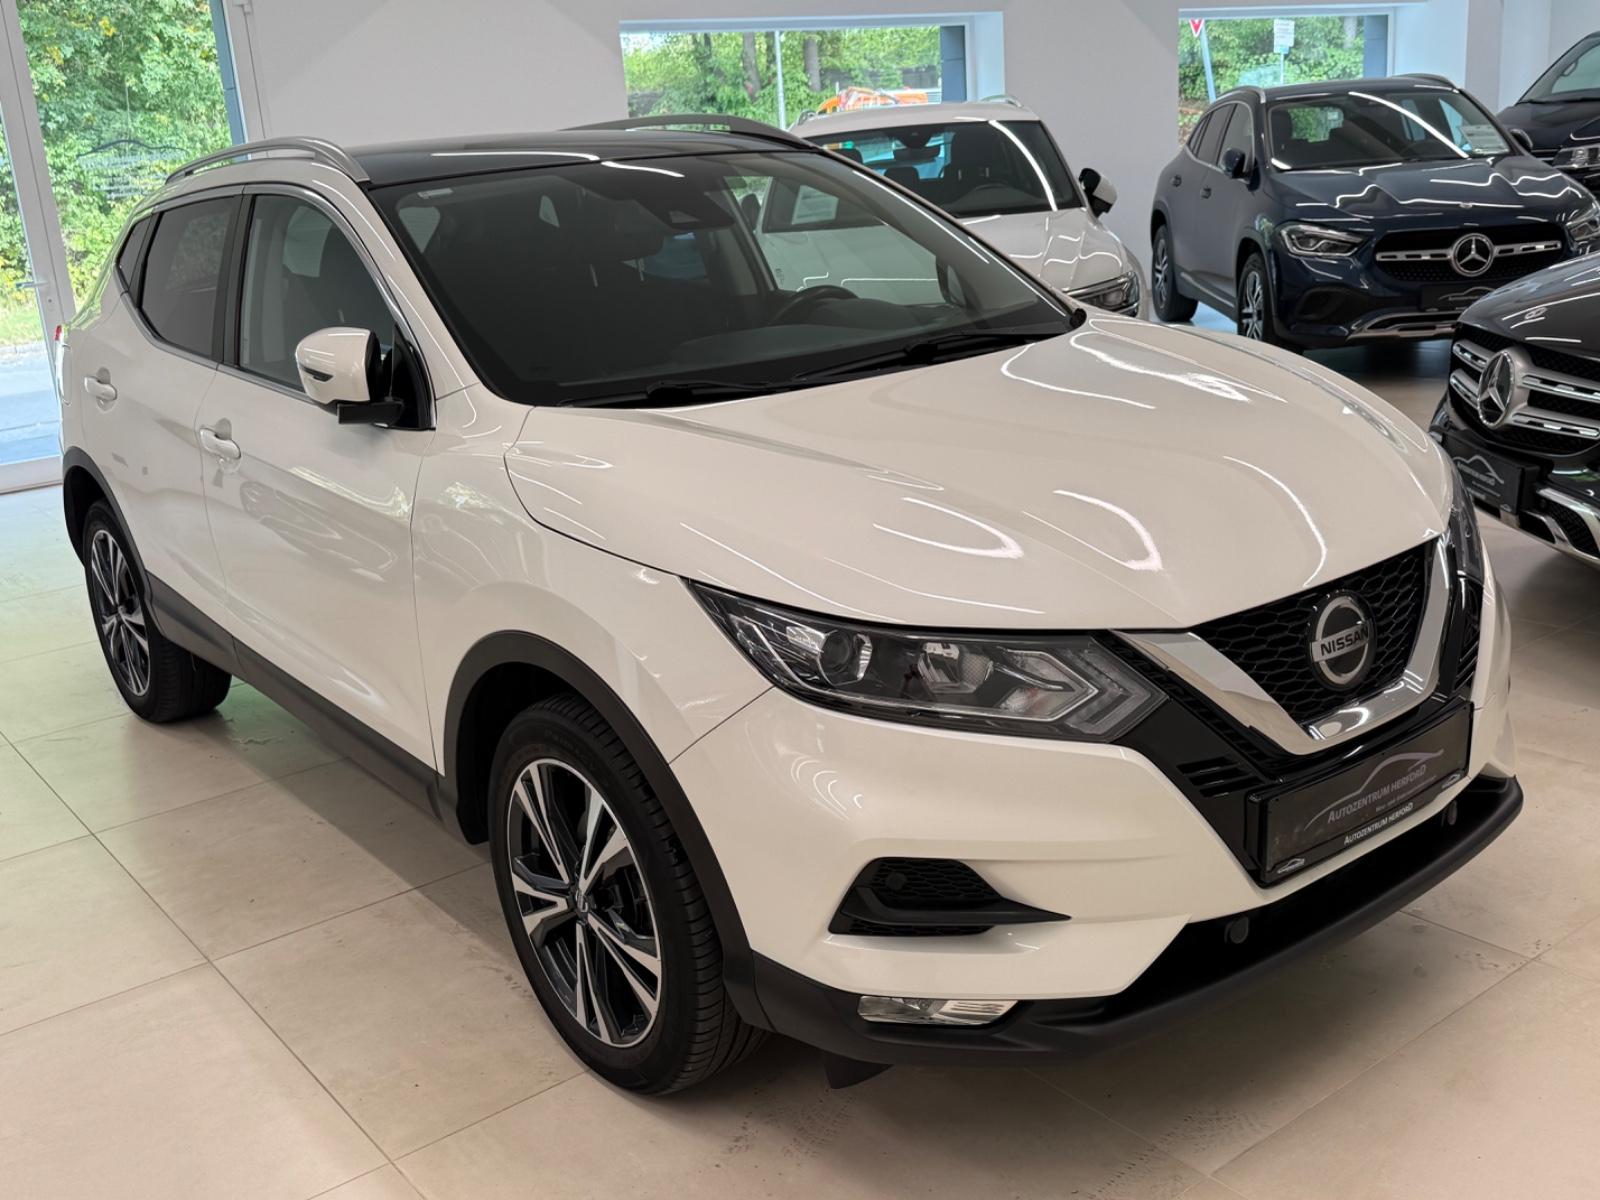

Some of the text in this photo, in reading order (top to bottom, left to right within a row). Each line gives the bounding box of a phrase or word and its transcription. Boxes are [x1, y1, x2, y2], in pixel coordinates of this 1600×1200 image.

[1320, 626, 1369, 656] NISSAN
[1327, 784, 1391, 824] AUTOZENTRUM
[1390, 764, 1427, 792] HERFORD
[1343, 802, 1414, 846] AUTOZENTRUM HERFORD
